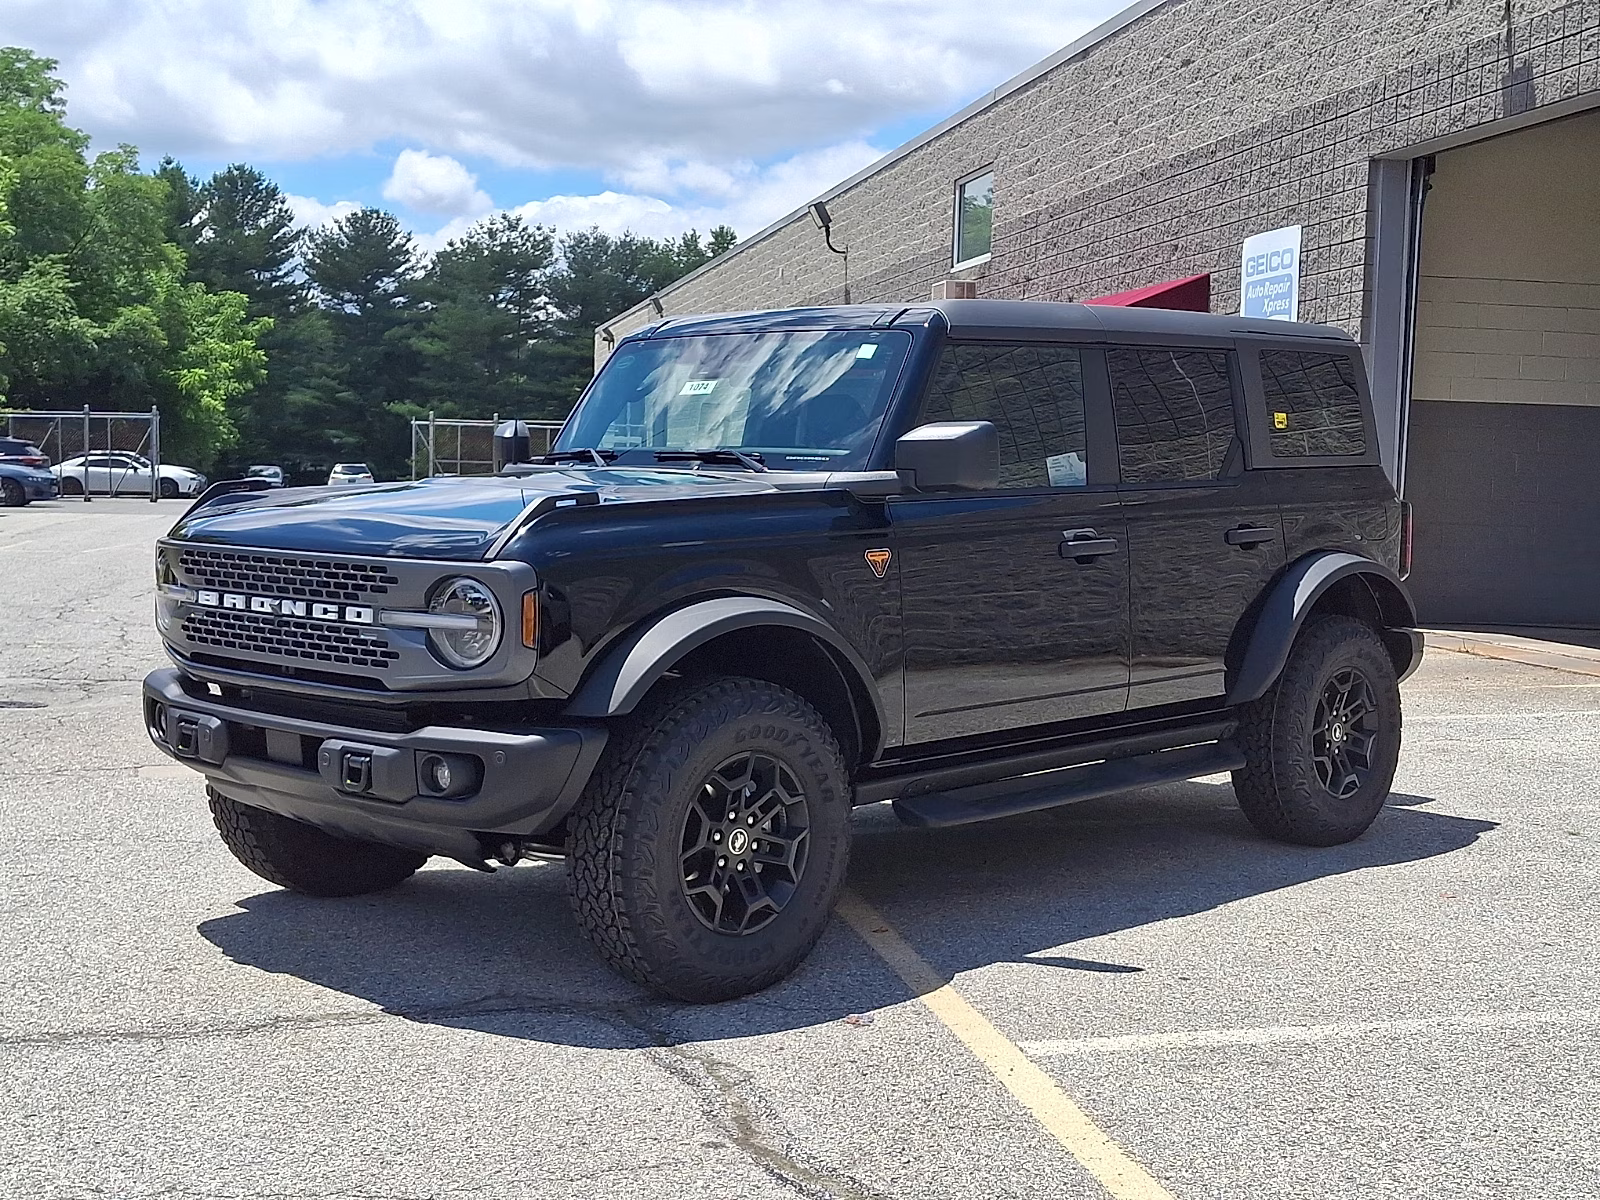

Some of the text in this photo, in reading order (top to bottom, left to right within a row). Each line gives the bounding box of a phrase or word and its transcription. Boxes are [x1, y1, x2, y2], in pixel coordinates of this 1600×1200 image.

[1246, 248, 1293, 277] GEICO
[1247, 277, 1290, 299] Auto Repair
[1262, 298, 1289, 316] Xpress
[690, 382, 709, 391] 1074
[198, 590, 373, 624] BRONCO
